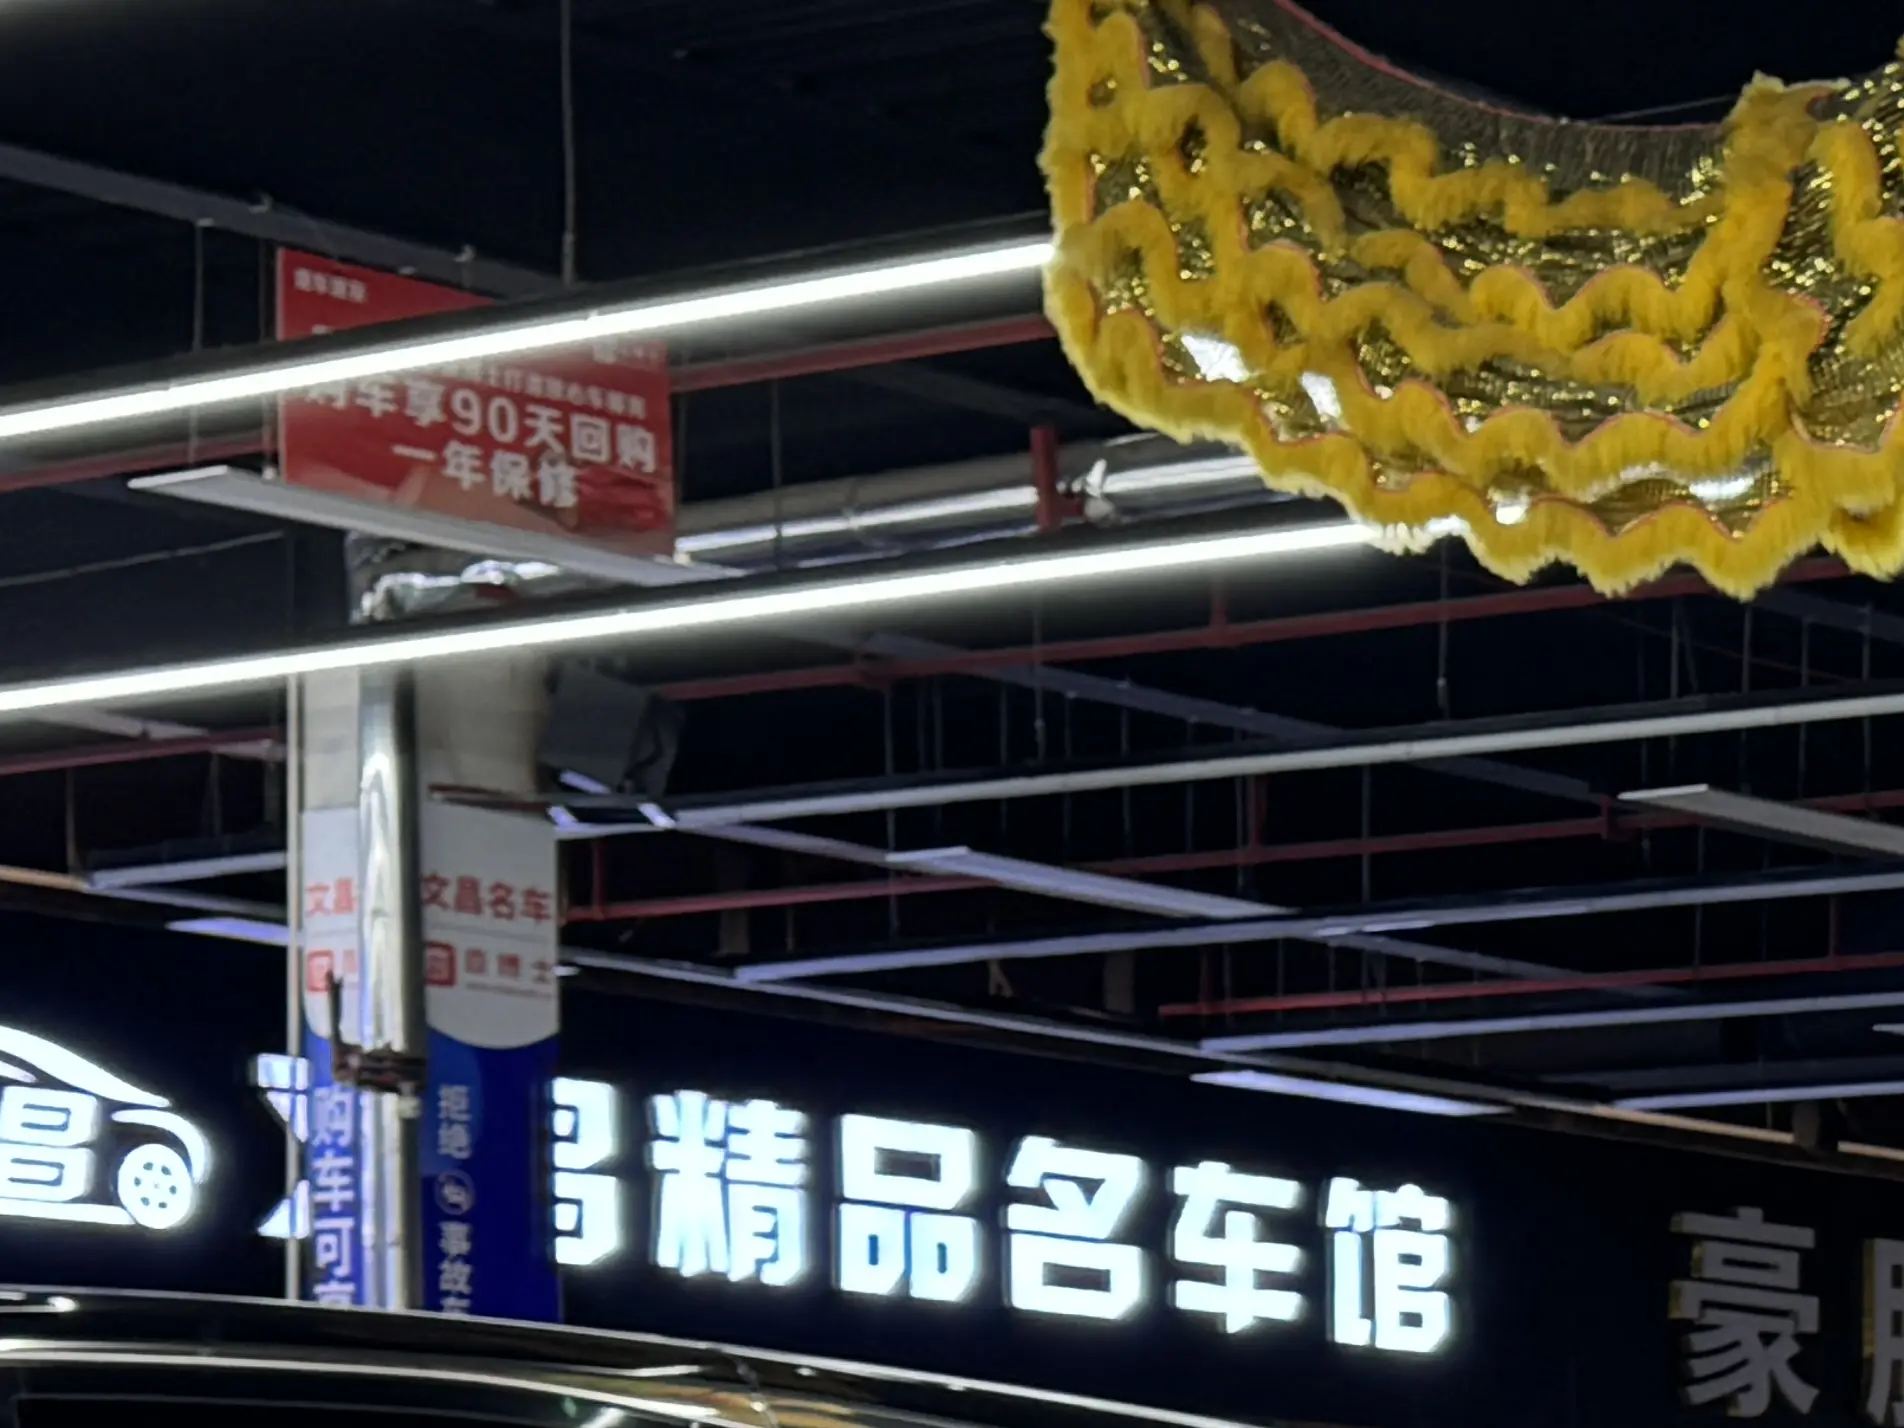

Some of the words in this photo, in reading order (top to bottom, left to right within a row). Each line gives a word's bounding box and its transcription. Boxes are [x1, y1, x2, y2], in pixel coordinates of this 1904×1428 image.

[391, 439, 579, 508] 一年保修
[423, 873, 553, 924] 文昌名车
